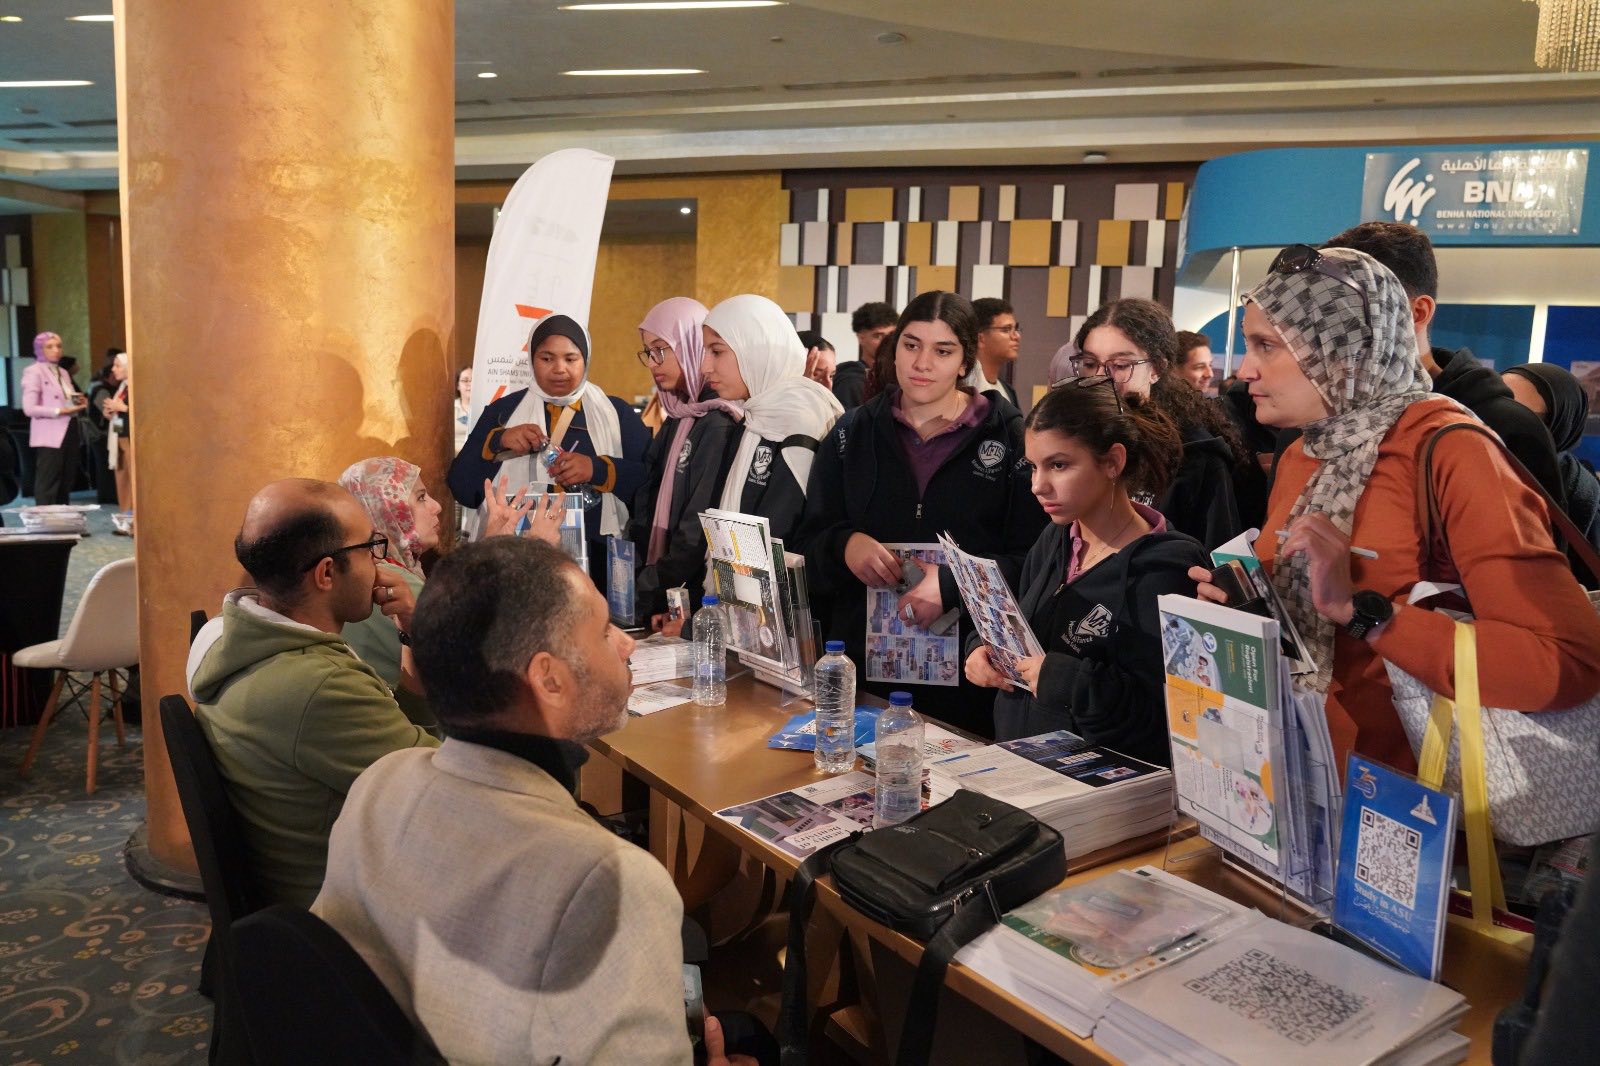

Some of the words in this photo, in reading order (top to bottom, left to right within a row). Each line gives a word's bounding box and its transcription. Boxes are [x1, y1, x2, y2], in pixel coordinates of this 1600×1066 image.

[1441, 154, 1487, 174] الأهلية
[1436, 209, 1465, 219] BENHA
[1466, 209, 1506, 219] NATIONAL
[1508, 209, 1557, 219] UNIVERSITY
[500, 369, 519, 377] SHAMS
[1354, 882, 1378, 903] Study
[1380, 896, 1389, 909] in
[1390, 905, 1413, 922] ASU
